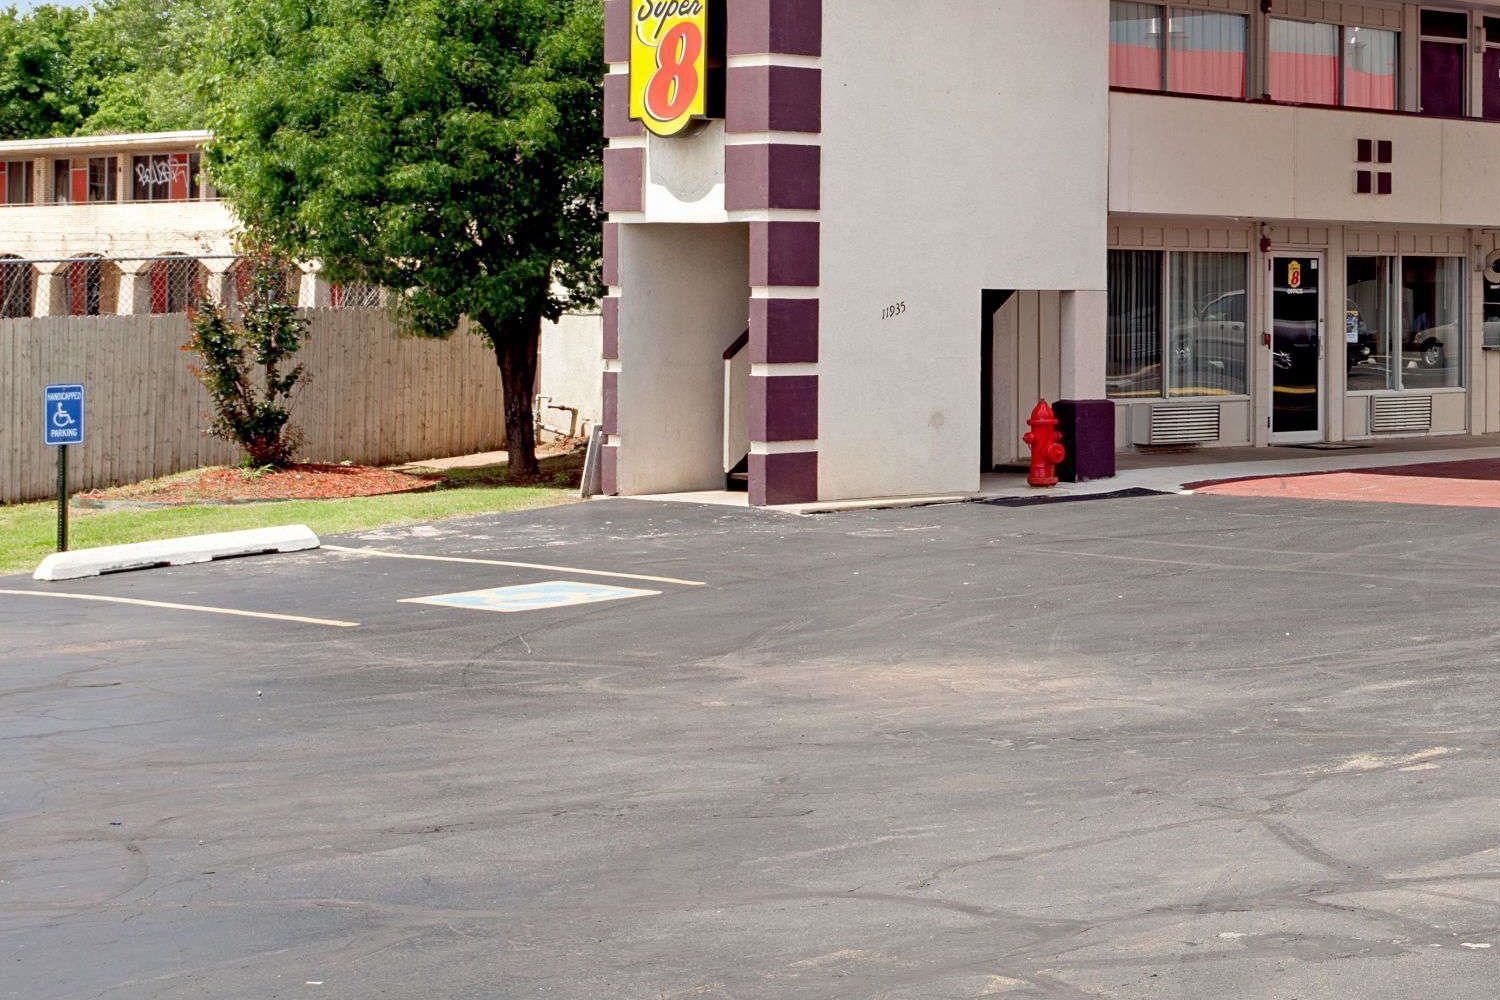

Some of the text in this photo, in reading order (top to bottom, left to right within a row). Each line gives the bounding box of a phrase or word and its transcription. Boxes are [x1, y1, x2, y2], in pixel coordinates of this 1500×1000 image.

[644, 21, 702, 121] 8
[1291, 270, 1299, 285] 8
[882, 301, 906, 319] 11935
[50, 429, 78, 438] PARKING
